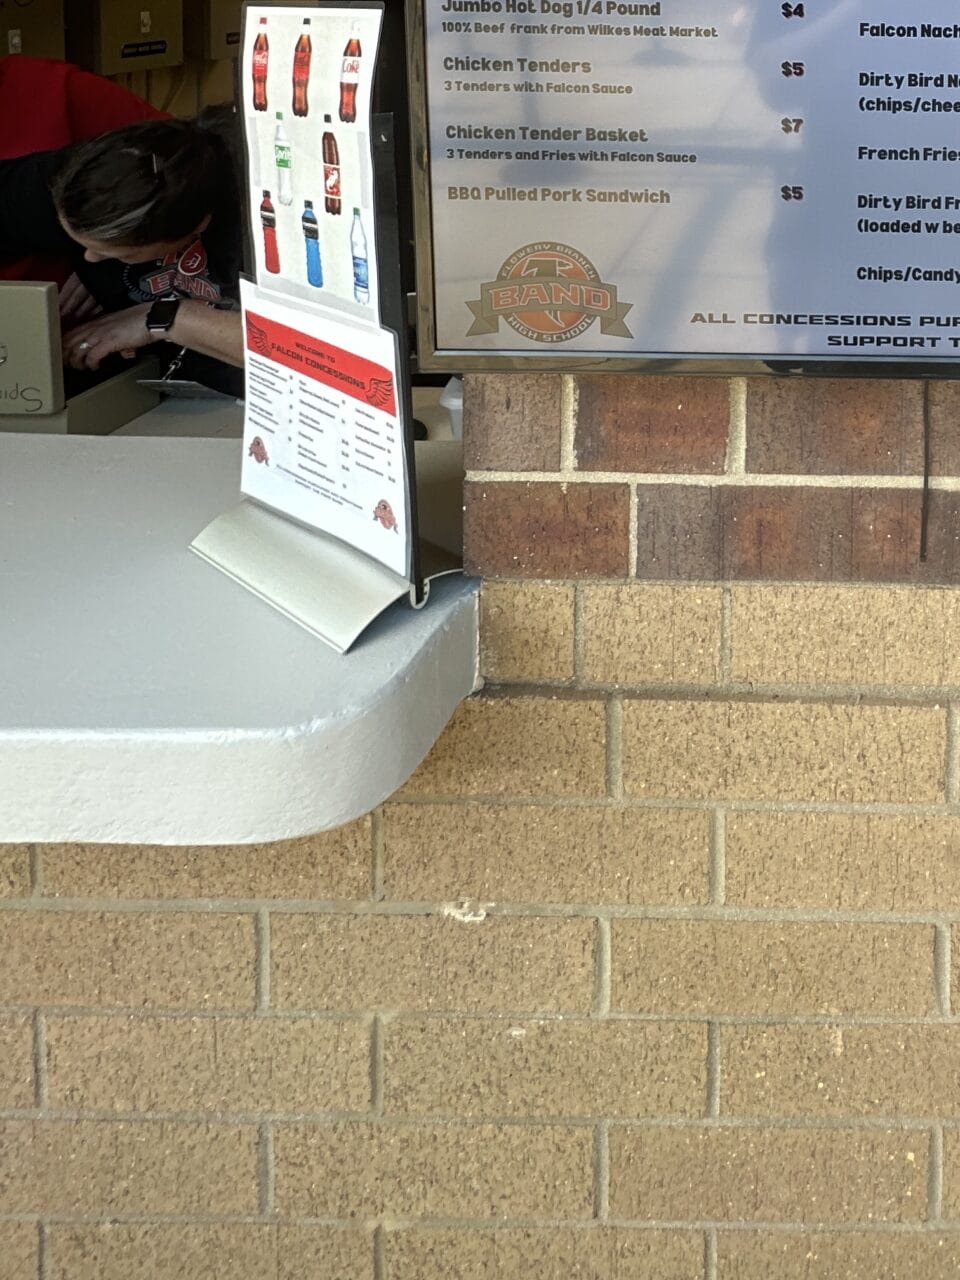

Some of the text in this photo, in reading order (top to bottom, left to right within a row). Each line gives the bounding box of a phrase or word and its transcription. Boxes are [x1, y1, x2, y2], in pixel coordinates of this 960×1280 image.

[505, 0, 537, 13] Hot
[540, 0, 575, 18] Dog
[577, 0, 603, 15] 1/4
[607, 1, 660, 16] Pound
[781, 2, 804, 18] $4
[442, 22, 718, 37] 100% Beef frank from Wilkes Meat Market
[860, 23, 918, 37] Falcon
[443, 56, 591, 73] Chicken Tenders
[781, 62, 804, 77] $5
[444, 81, 633, 94] 3 Tenders with Falcon Sauce
[859, 72, 904, 89] Dirty
[908, 73, 944, 87] Bird
[446, 125, 648, 142] Chicken Tender Basket
[781, 118, 803, 133] $7
[447, 149, 697, 162] 3 Tenders and Fries with Falcon Sauce
[858, 147, 920, 160] French
[448, 187, 670, 203] BBQ Pulled Pork Sandwich
[781, 186, 803, 200] $5
[857, 194, 902, 211] Dirty
[906, 195, 942, 209] Bird
[857, 219, 922, 233] (loaded
[925, 223, 939, 233] w
[501, 243, 597, 279] FLOWERY BRANCH
[489, 282, 611, 311] BAND
[690, 313, 736, 323] ALL
[743, 314, 911, 326] CONCESSIONS
[506, 316, 595, 342] HIGH SCHOOL
[827, 336, 941, 347] SUPPORT
[295, 342, 336, 363] WELCOME TO
[271, 342, 303, 362] FALCON
[305, 357, 365, 390] CONCESSIONS
